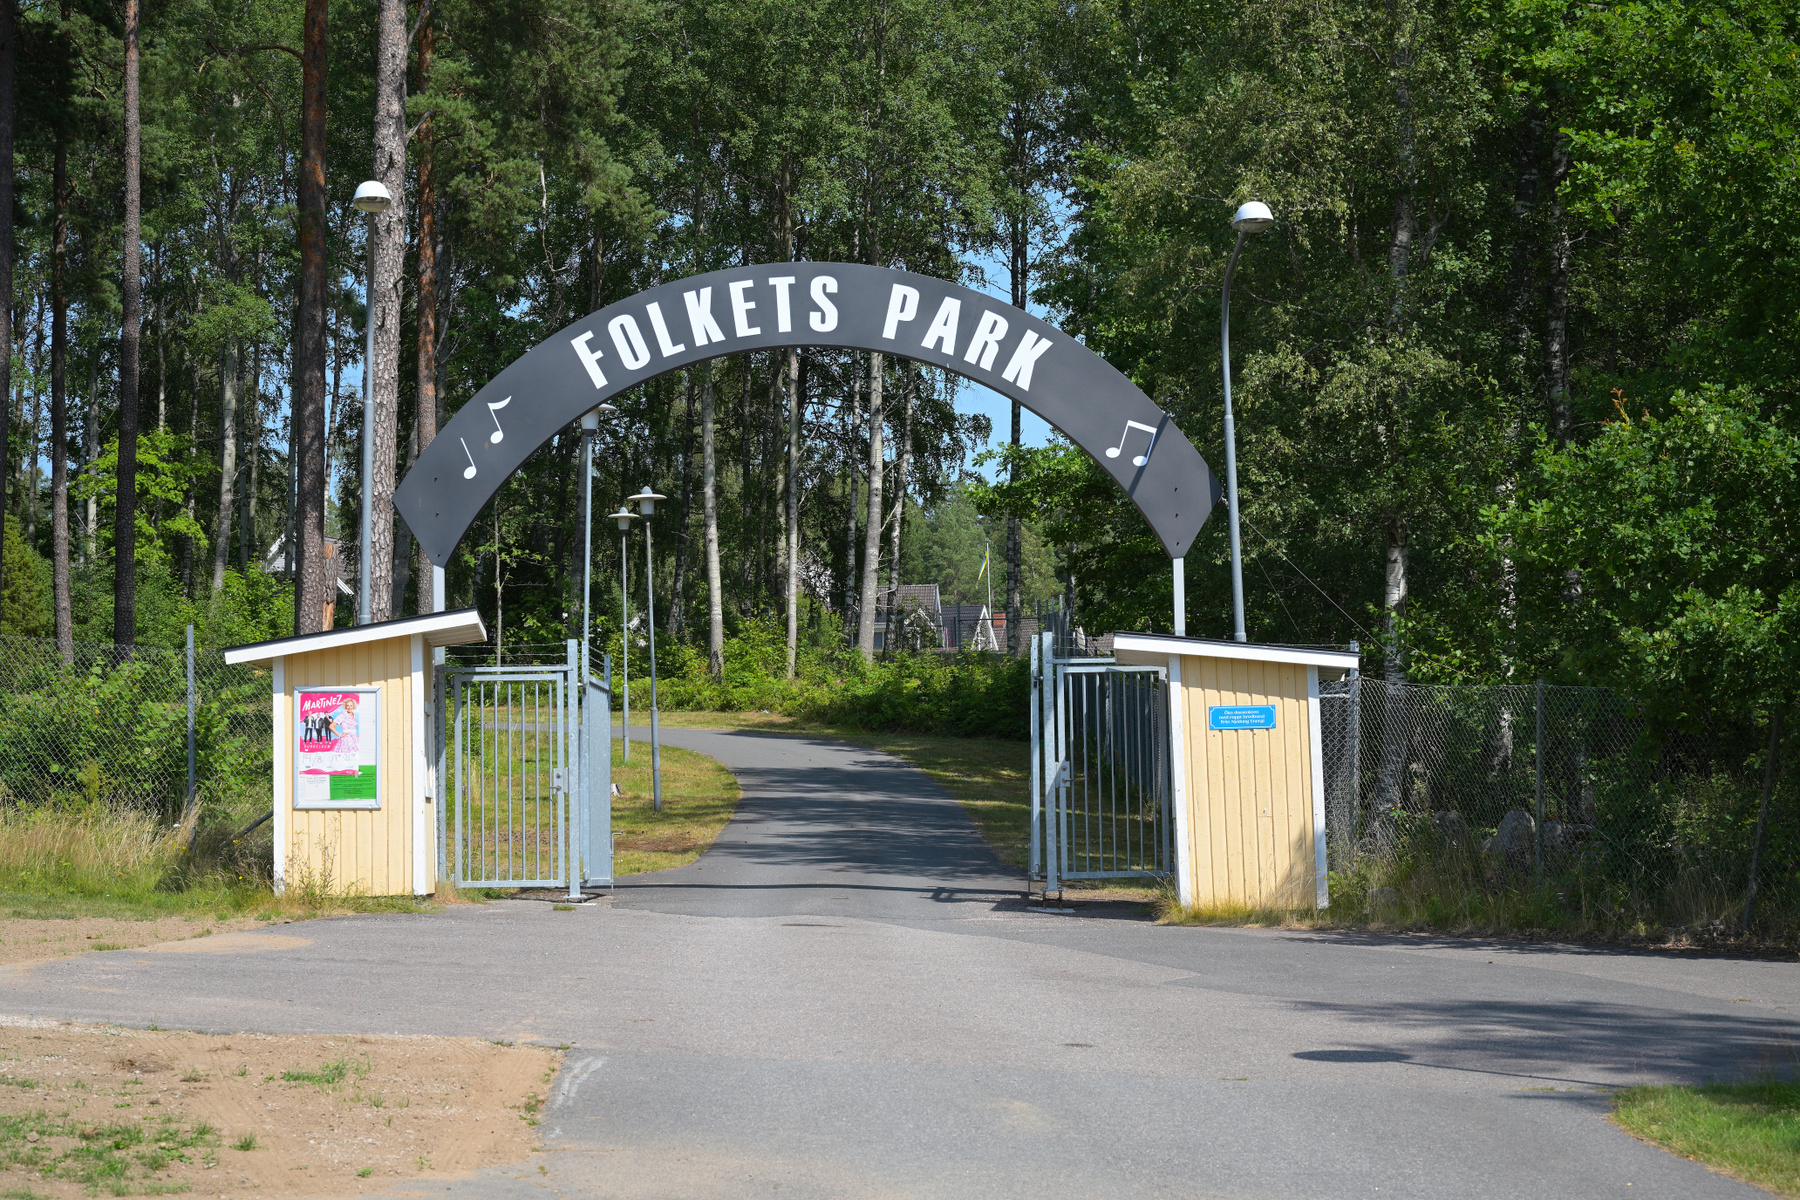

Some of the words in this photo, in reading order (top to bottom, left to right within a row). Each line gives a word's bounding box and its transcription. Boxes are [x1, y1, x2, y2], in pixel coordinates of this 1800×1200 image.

[570, 275, 838, 389] FOLKETS
[882, 283, 1054, 392] PARK
[302, 694, 343, 712] MARTINEZ
